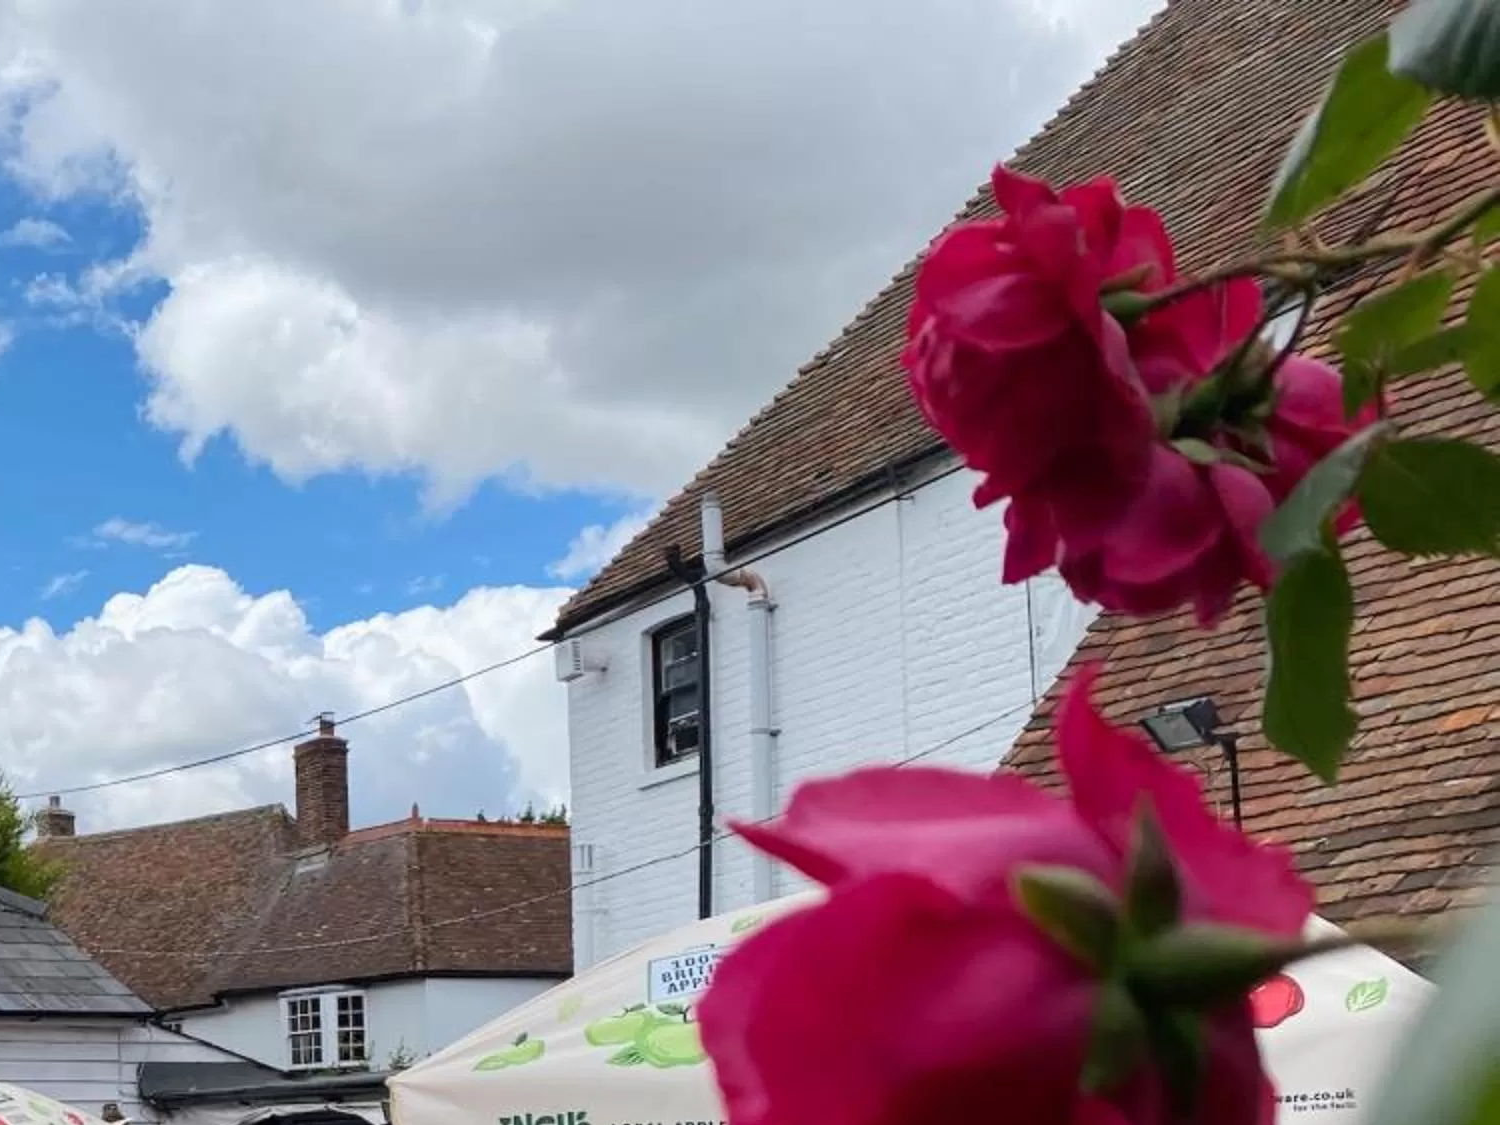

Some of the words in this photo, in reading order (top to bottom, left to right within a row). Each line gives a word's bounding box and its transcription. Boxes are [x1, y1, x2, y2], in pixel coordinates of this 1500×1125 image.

[670, 953, 717, 969] 100
[661, 963, 713, 983] BRITI
[667, 976, 710, 994] APPL
